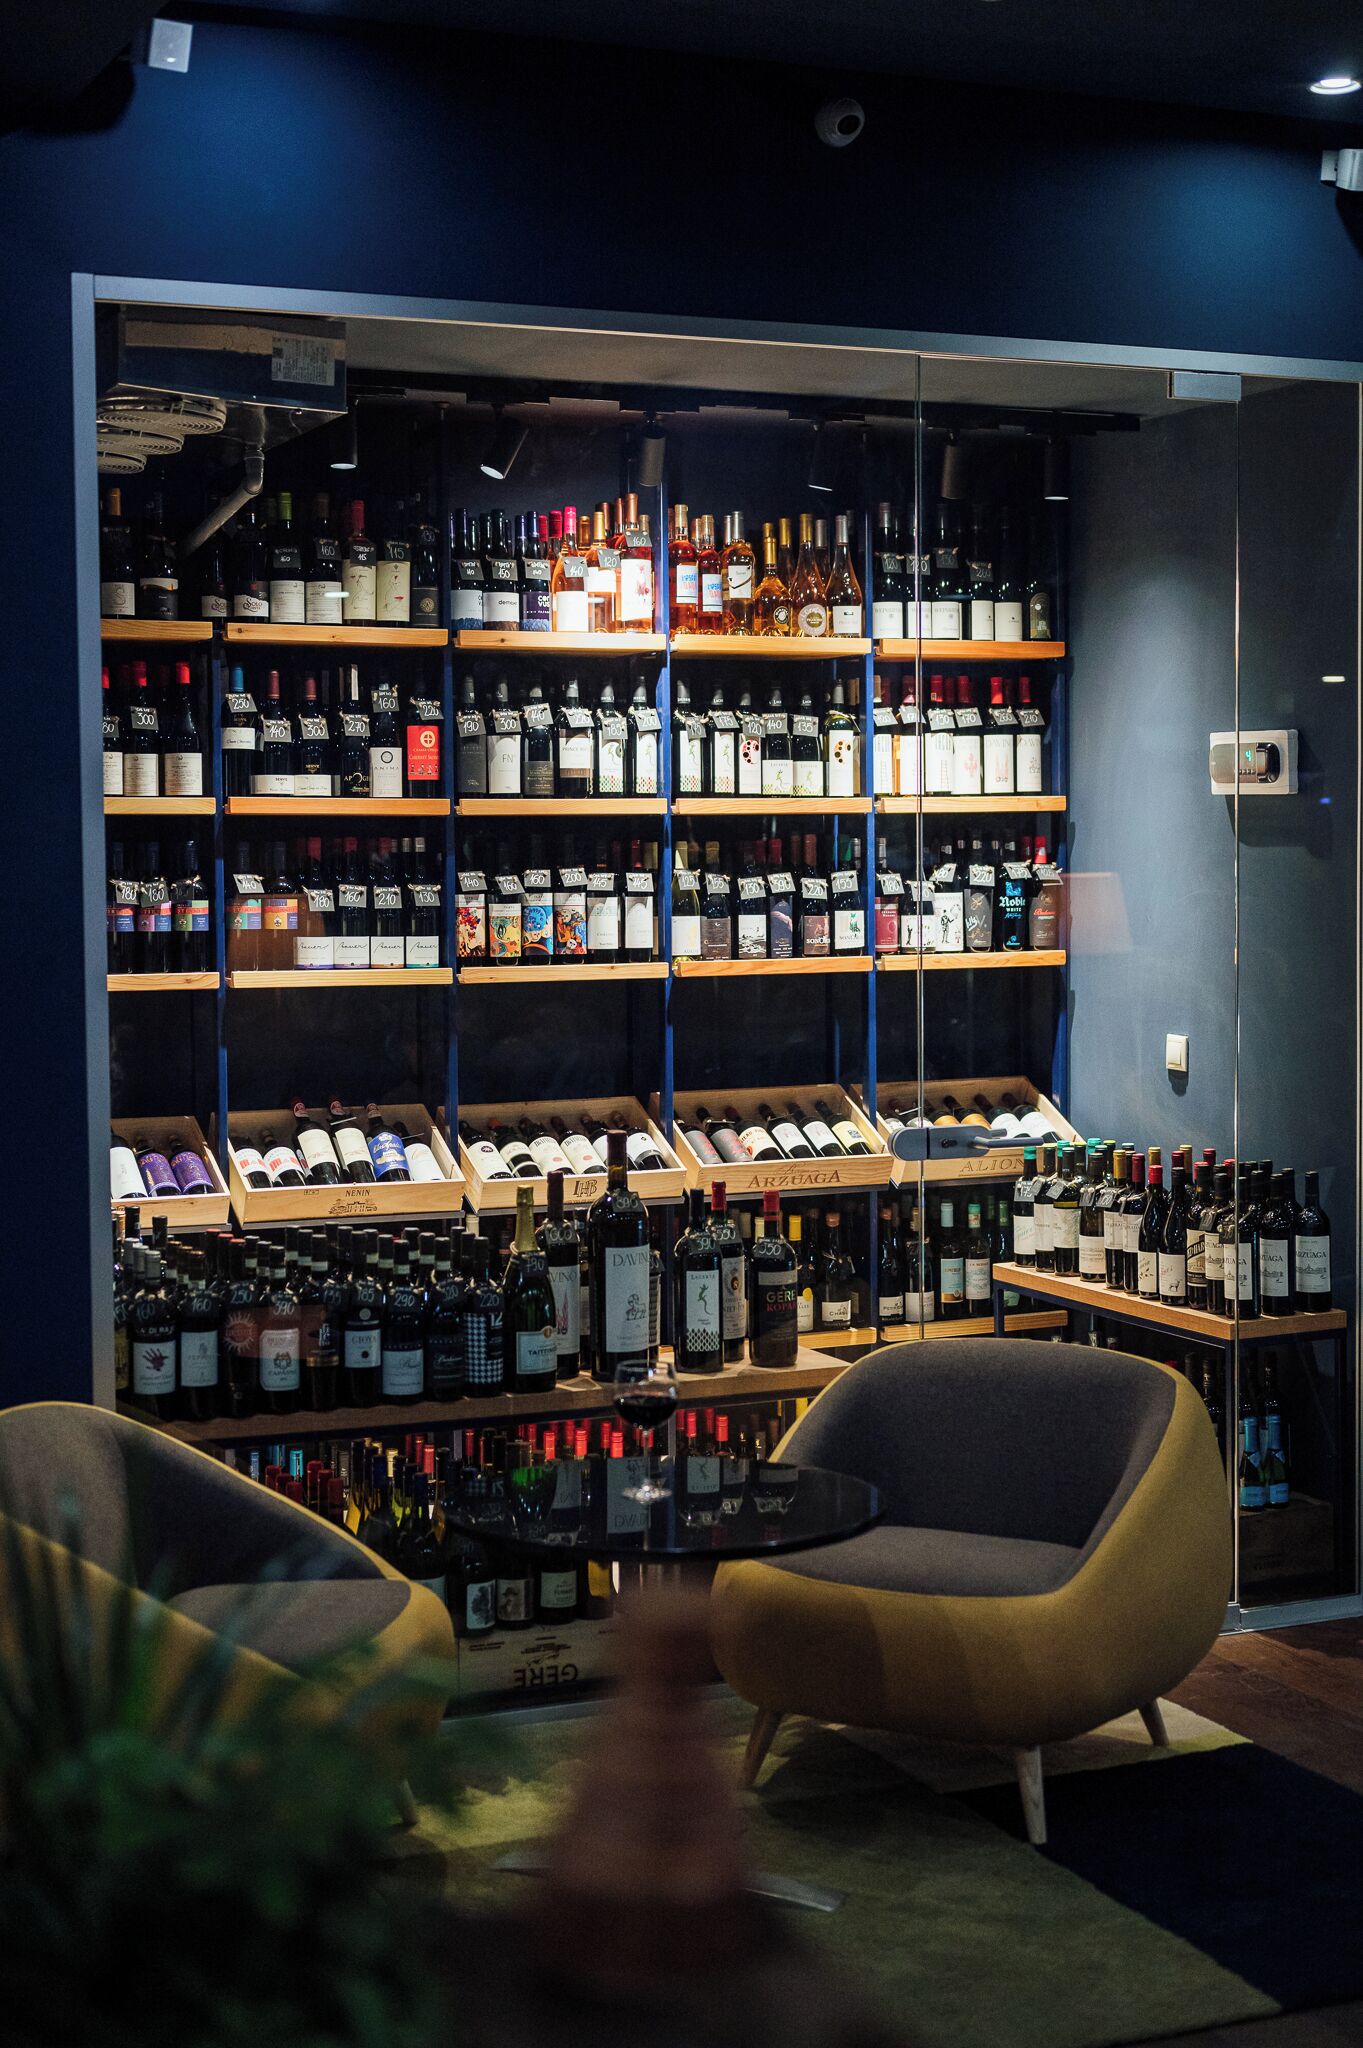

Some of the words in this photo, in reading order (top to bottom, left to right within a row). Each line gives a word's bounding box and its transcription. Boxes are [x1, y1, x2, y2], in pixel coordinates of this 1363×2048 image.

[233, 699, 250, 711] 250
[136, 712, 155, 726] 300
[499, 717, 517, 731] 300
[348, 721, 366, 733] 270
[463, 720, 480, 734] 190
[564, 872, 582, 884] 200
[973, 870, 992, 883] 220
[148, 888, 164, 902] 180
[313, 894, 331, 909] 180
[378, 892, 397, 906] 210
[418, 890, 435, 903] 130
[746, 1168, 841, 1189] ARZUAGA
[345, 1188, 371, 1197] NENIN
[394, 1292, 416, 1308] 290
[273, 1301, 296, 1316] 390
[512, 1662, 579, 1690] GERE
